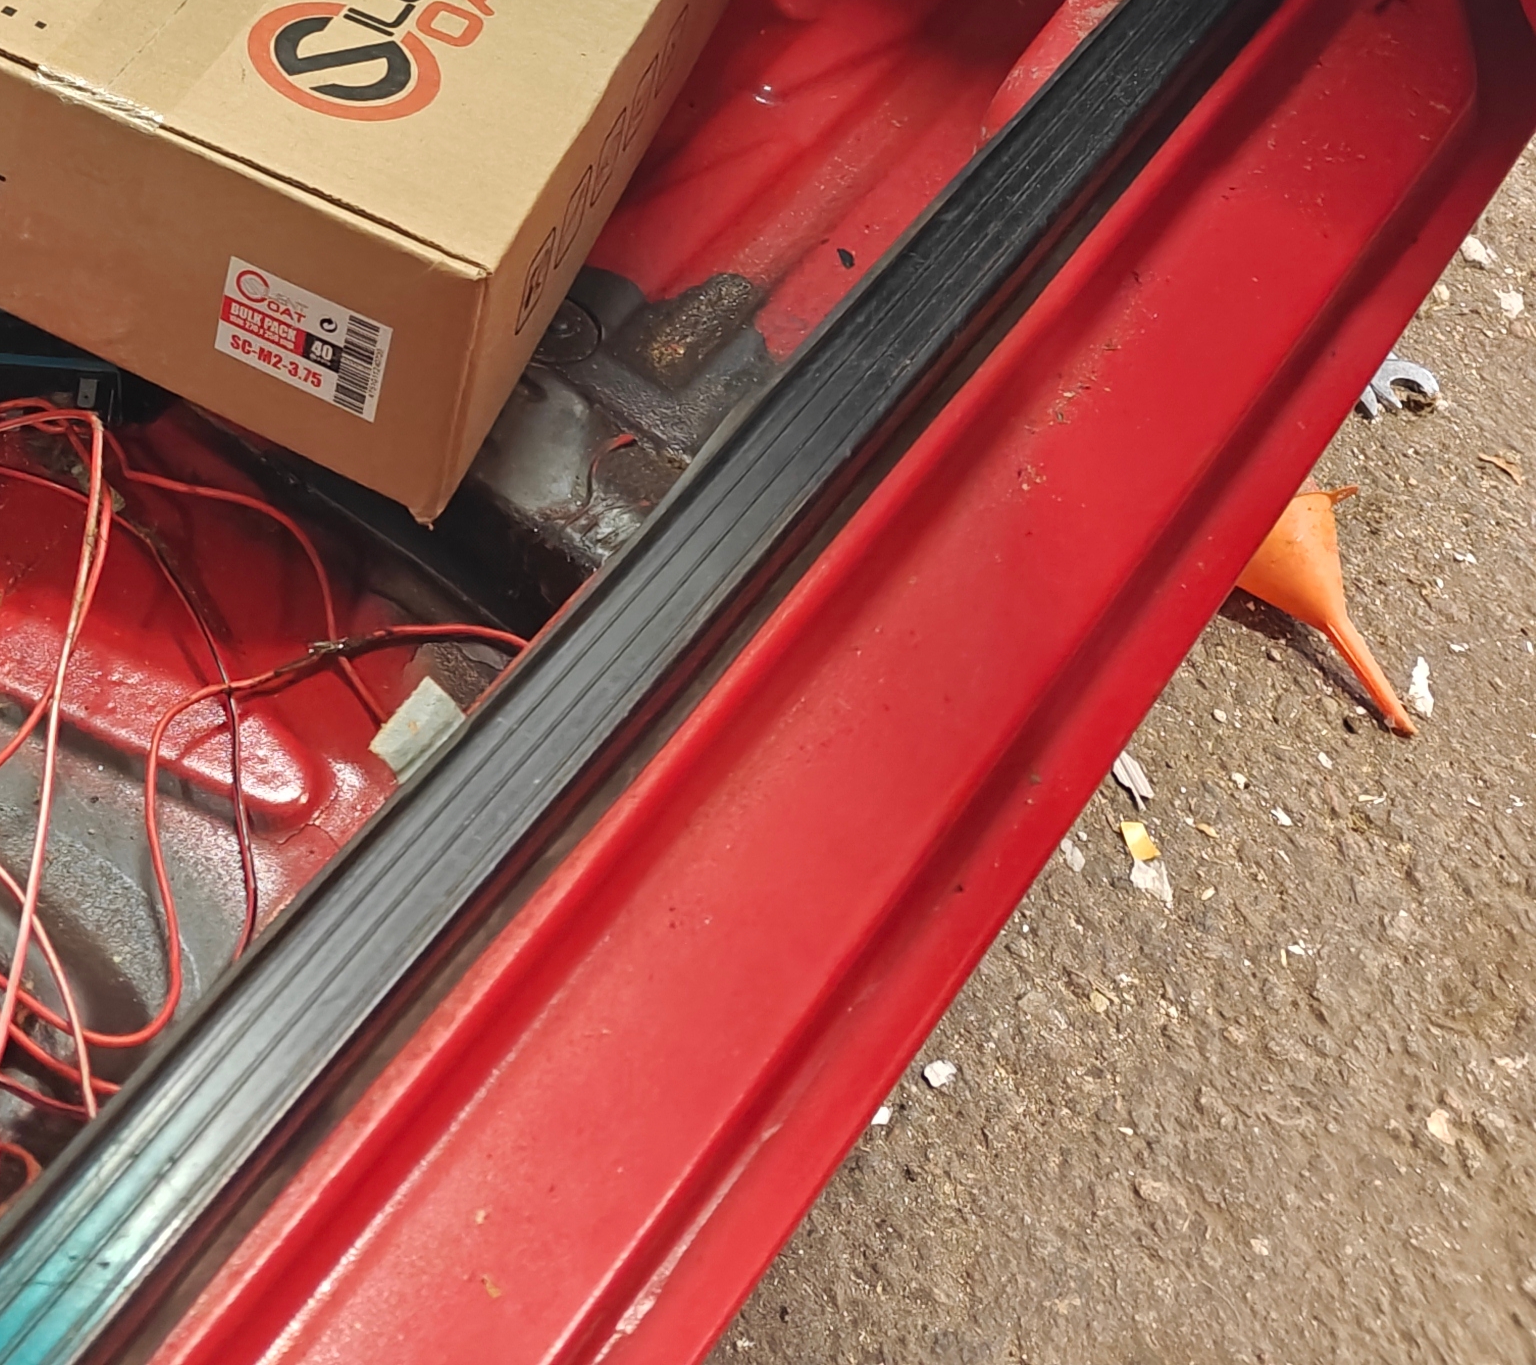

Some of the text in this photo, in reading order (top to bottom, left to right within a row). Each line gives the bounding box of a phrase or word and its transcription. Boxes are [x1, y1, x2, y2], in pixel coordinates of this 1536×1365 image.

[229, 302, 263, 327] BULK
[263, 316, 298, 342] PACK
[230, 334, 323, 389] SC-M2-3.75
[310, 340, 334, 361] 40
